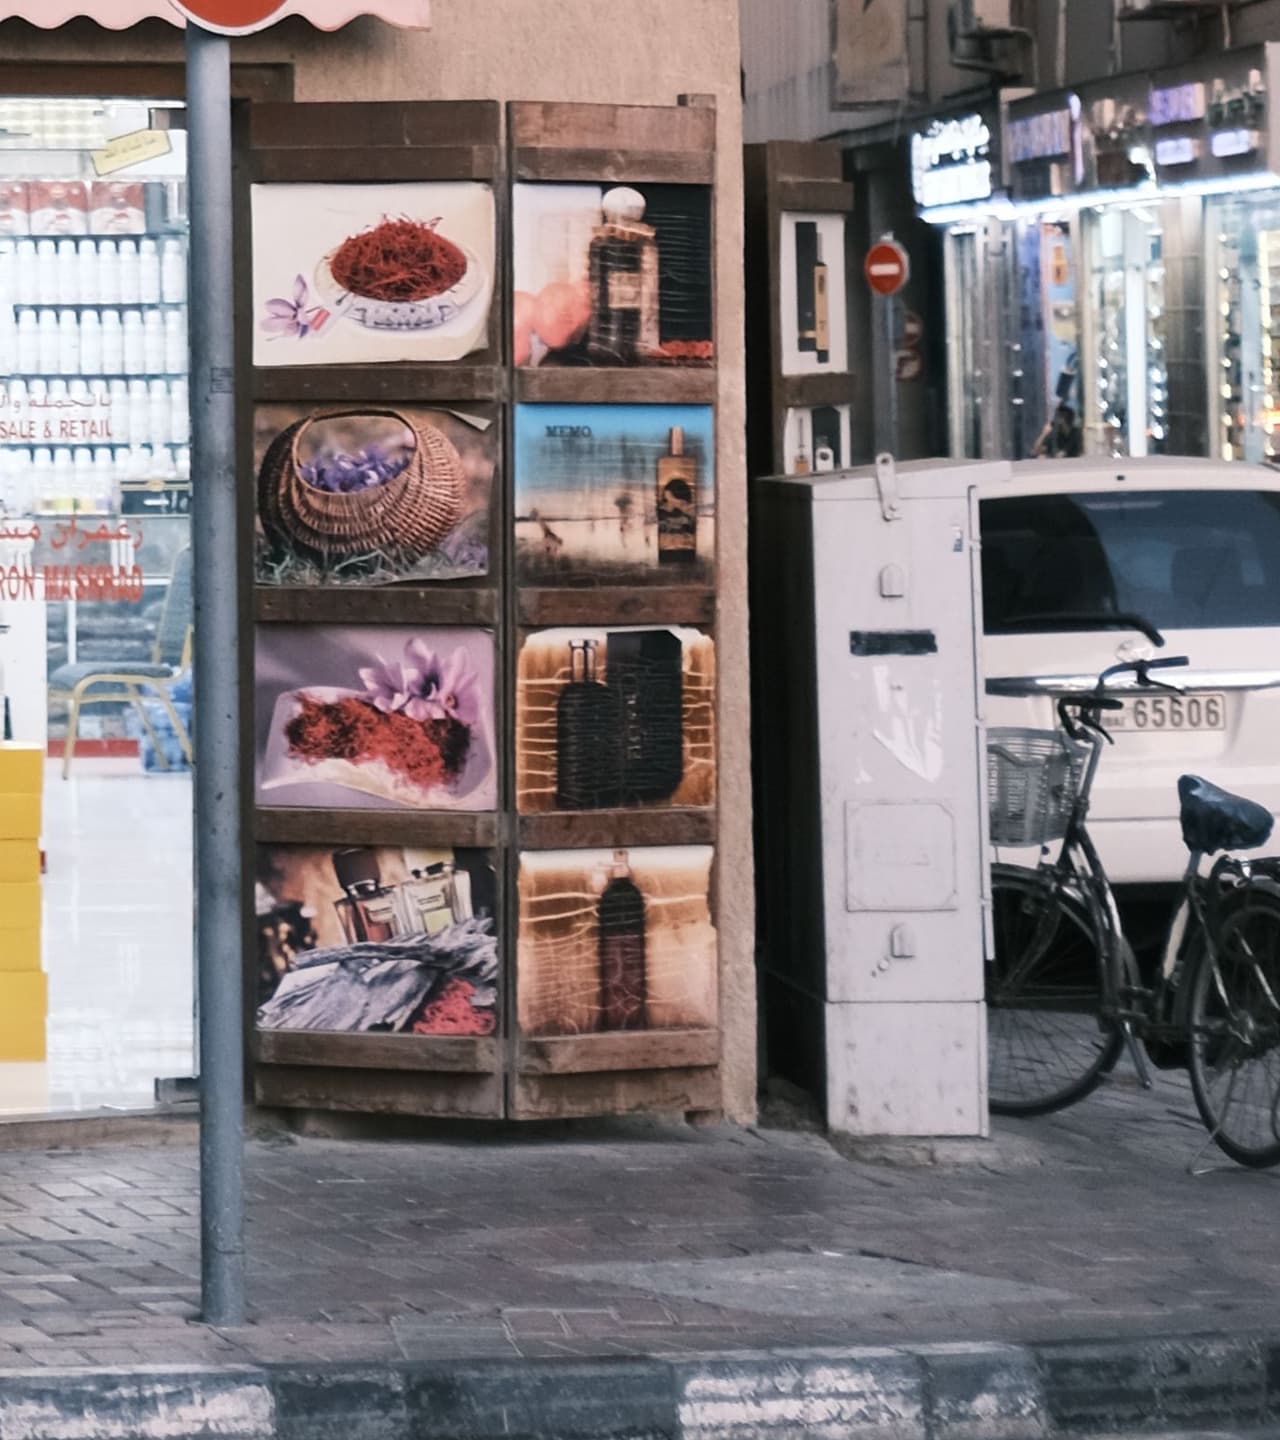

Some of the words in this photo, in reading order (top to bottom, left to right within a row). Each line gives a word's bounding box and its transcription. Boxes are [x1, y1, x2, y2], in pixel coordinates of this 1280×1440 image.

[44, 420, 53, 438] &
[59, 419, 114, 438] RETAIL
[544, 425, 593, 438] MEMO
[1133, 698, 1220, 728] 65606
